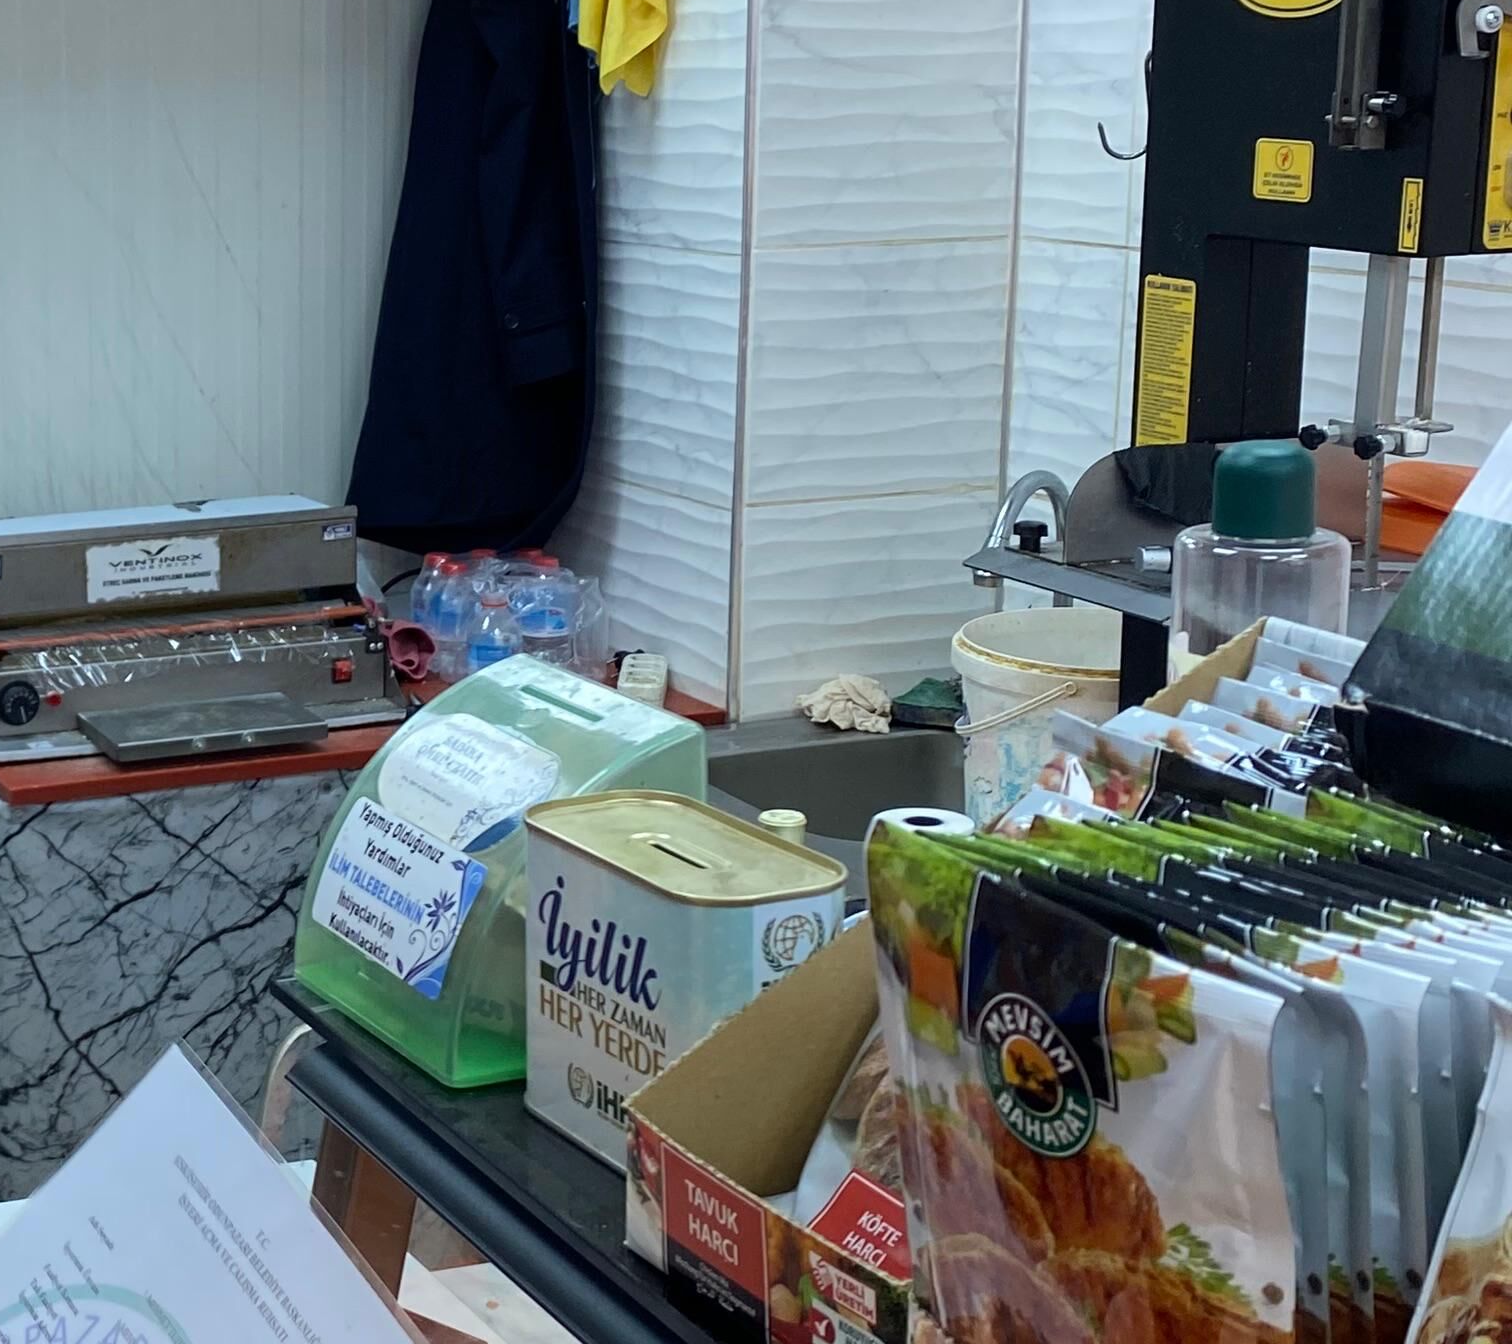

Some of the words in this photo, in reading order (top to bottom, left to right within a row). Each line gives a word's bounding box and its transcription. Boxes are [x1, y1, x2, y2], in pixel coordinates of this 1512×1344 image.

[109, 552, 203, 569] VENTINOX
[359, 802, 393, 838] Yapmış
[392, 822, 445, 864] Olduğunuz
[362, 837, 412, 878] Yardımlar
[337, 886, 379, 929] İhtiyaçları
[539, 874, 663, 1012] İyilik
[539, 983, 583, 1039] HER
[574, 979, 605, 1014] HER
[609, 998, 666, 1049] ZAMAN
[996, 1090, 1088, 1147] BAHARAT
[684, 1179, 739, 1236] TAVUK
[856, 1209, 904, 1248] KÖFTE
[688, 1213, 739, 1266] HARCI
[842, 1232, 887, 1267] HARCI
[246, 1253, 286, 1301] BELEDİYE
